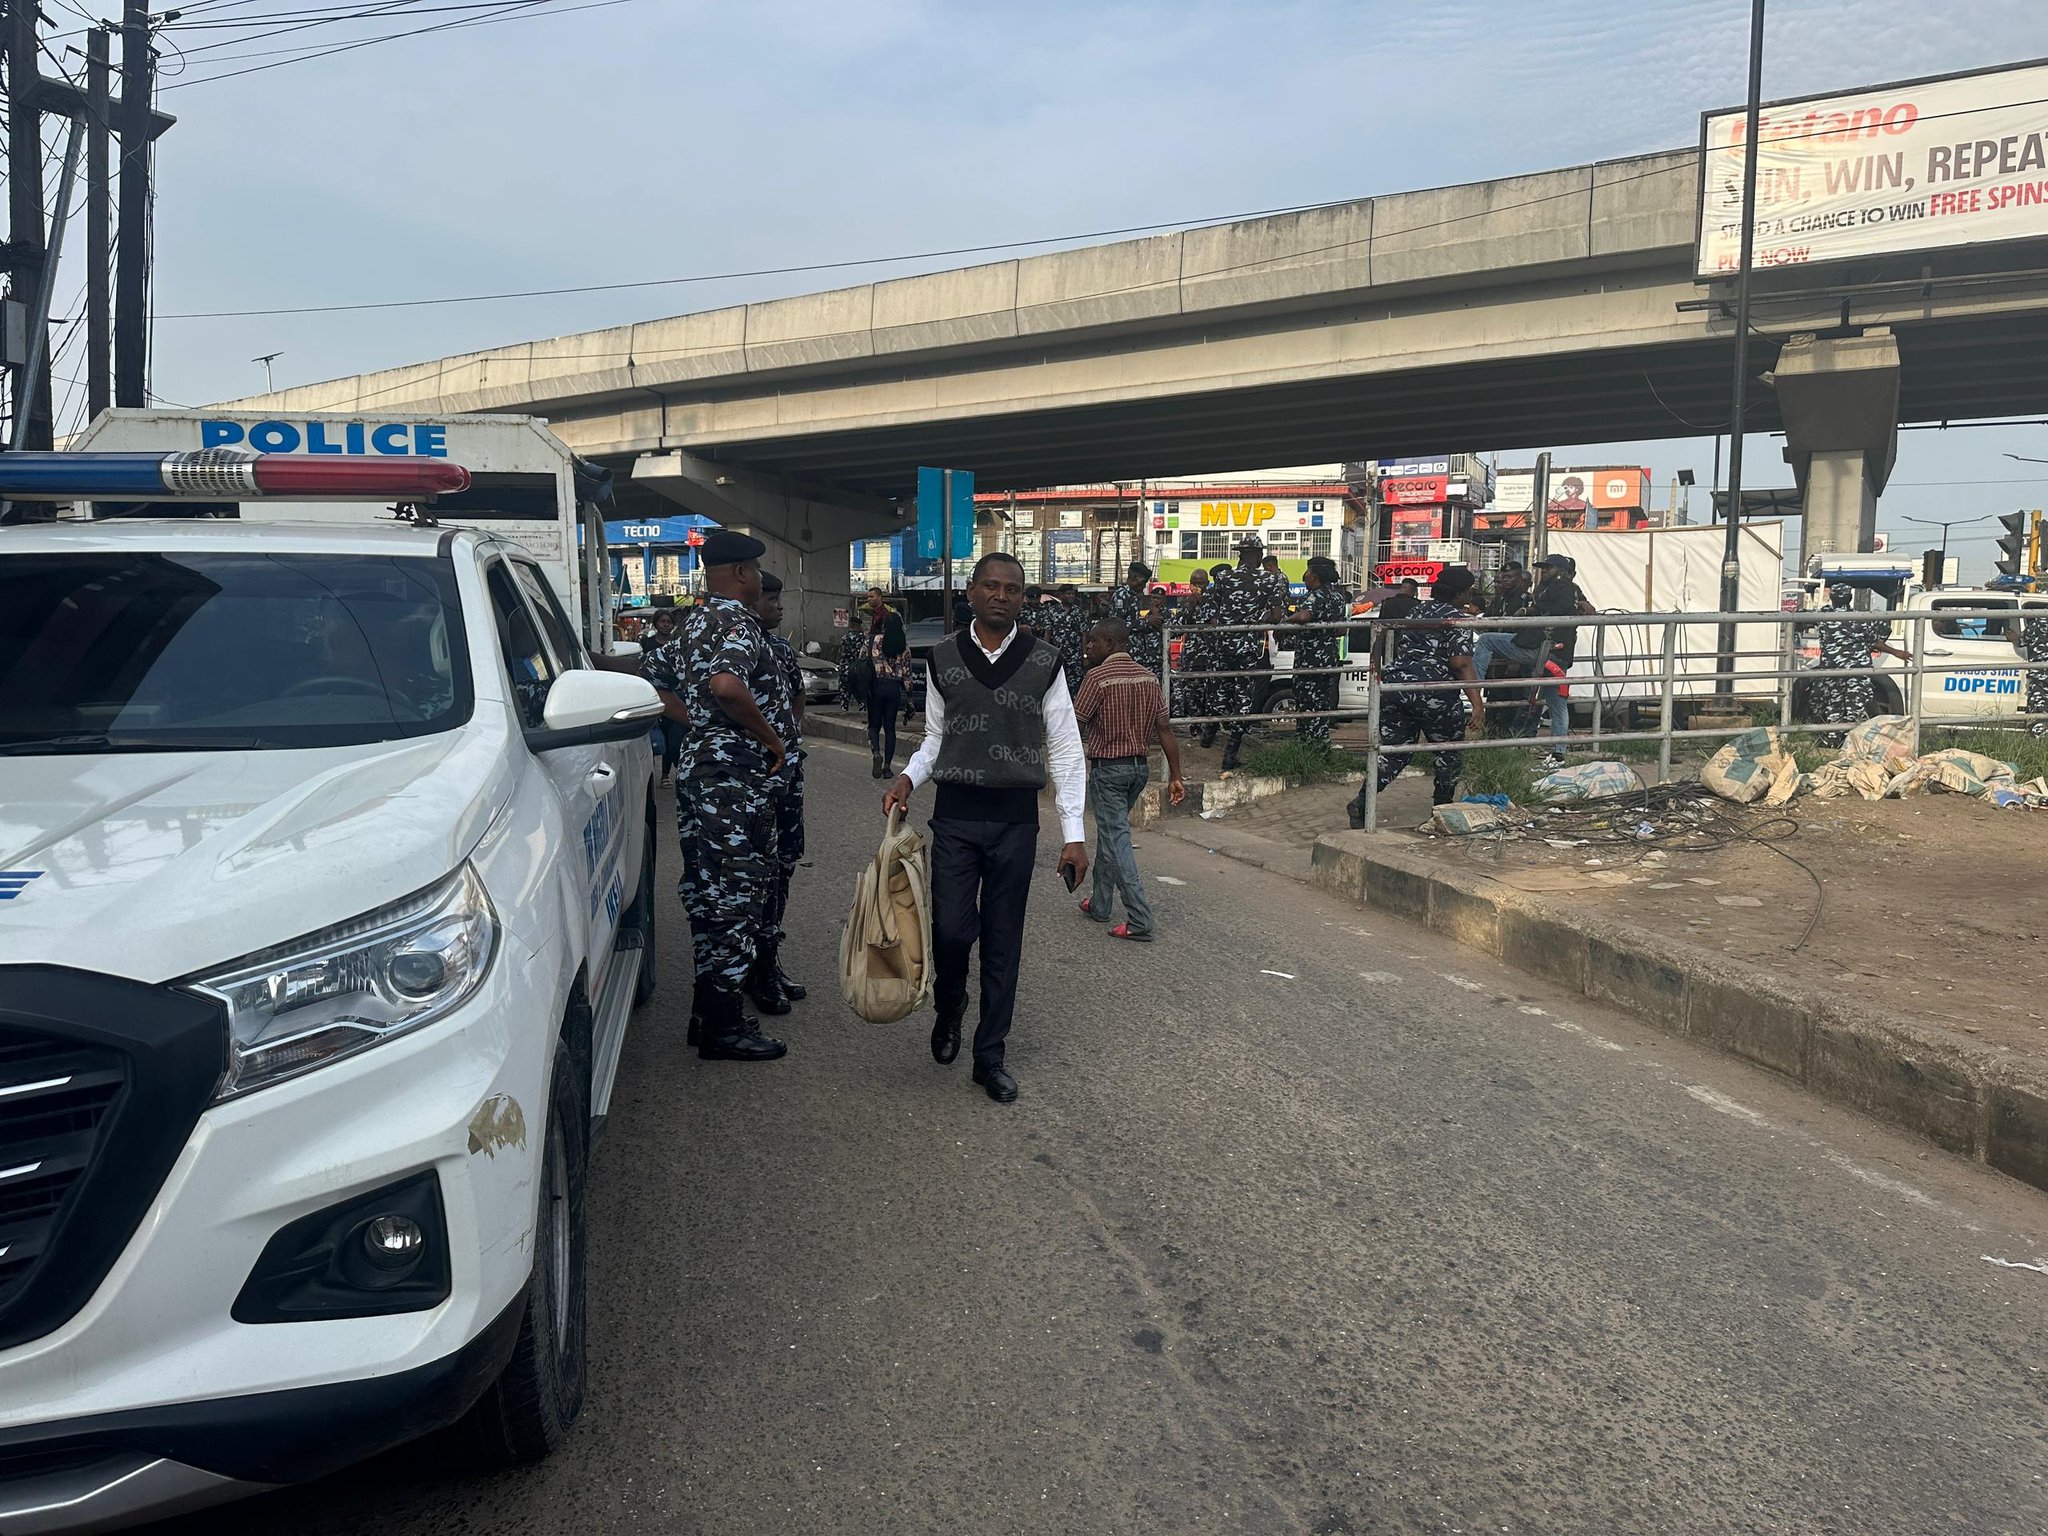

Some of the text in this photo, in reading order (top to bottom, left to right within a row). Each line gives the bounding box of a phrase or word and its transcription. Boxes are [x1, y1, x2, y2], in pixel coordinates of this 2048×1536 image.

[1823, 151, 1915, 195] WIN,
[1927, 131, 2048, 183] REPEA
[1720, 220, 1770, 240] STD
[1789, 210, 1855, 232] CHANCE
[1861, 207, 1884, 224] TO
[1889, 202, 1925, 221] WIN
[1930, 189, 1981, 216] FREE
[1718, 245, 1811, 270] PL NOW
[201, 420, 447, 457] POLICE
[1200, 502, 1276, 526] MVP
[623, 525, 660, 537] TECNO
